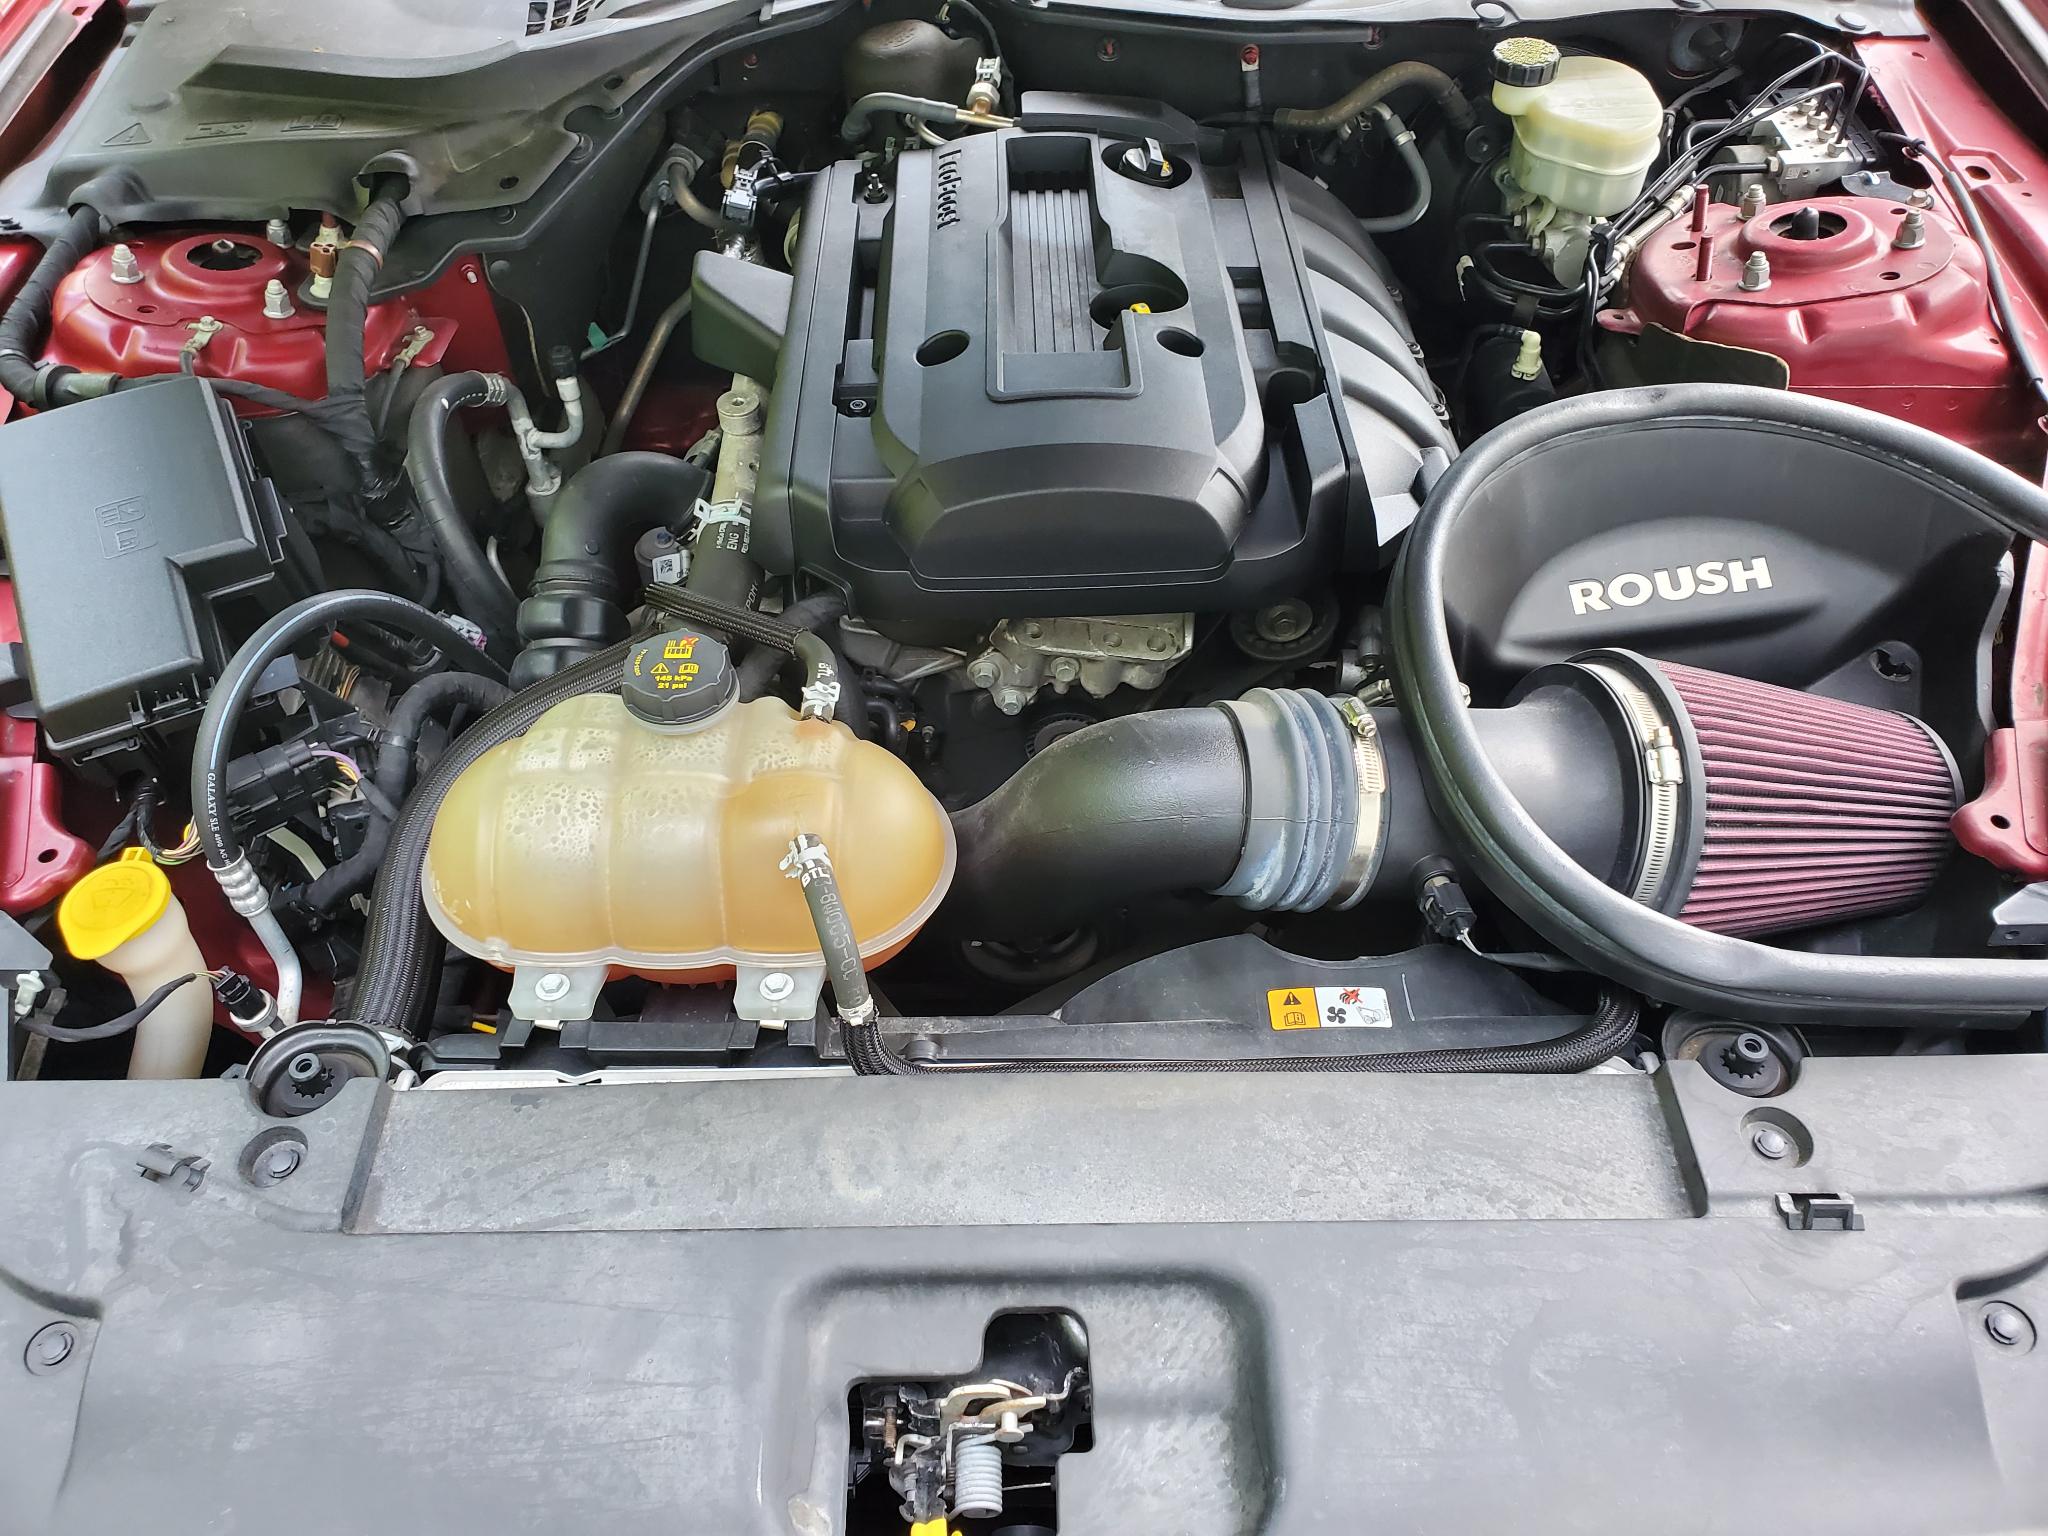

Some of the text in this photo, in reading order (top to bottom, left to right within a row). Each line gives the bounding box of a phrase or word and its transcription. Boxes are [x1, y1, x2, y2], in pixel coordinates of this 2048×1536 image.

[726, 532, 739, 550] ENG
[1568, 555, 1773, 616] ROUSH
[654, 674, 693, 682] 145 kPa
[671, 682, 688, 690] psi
[207, 772, 217, 817] GALAXY
[209, 817, 220, 832] SLE
[801, 866, 830, 888] BTL
